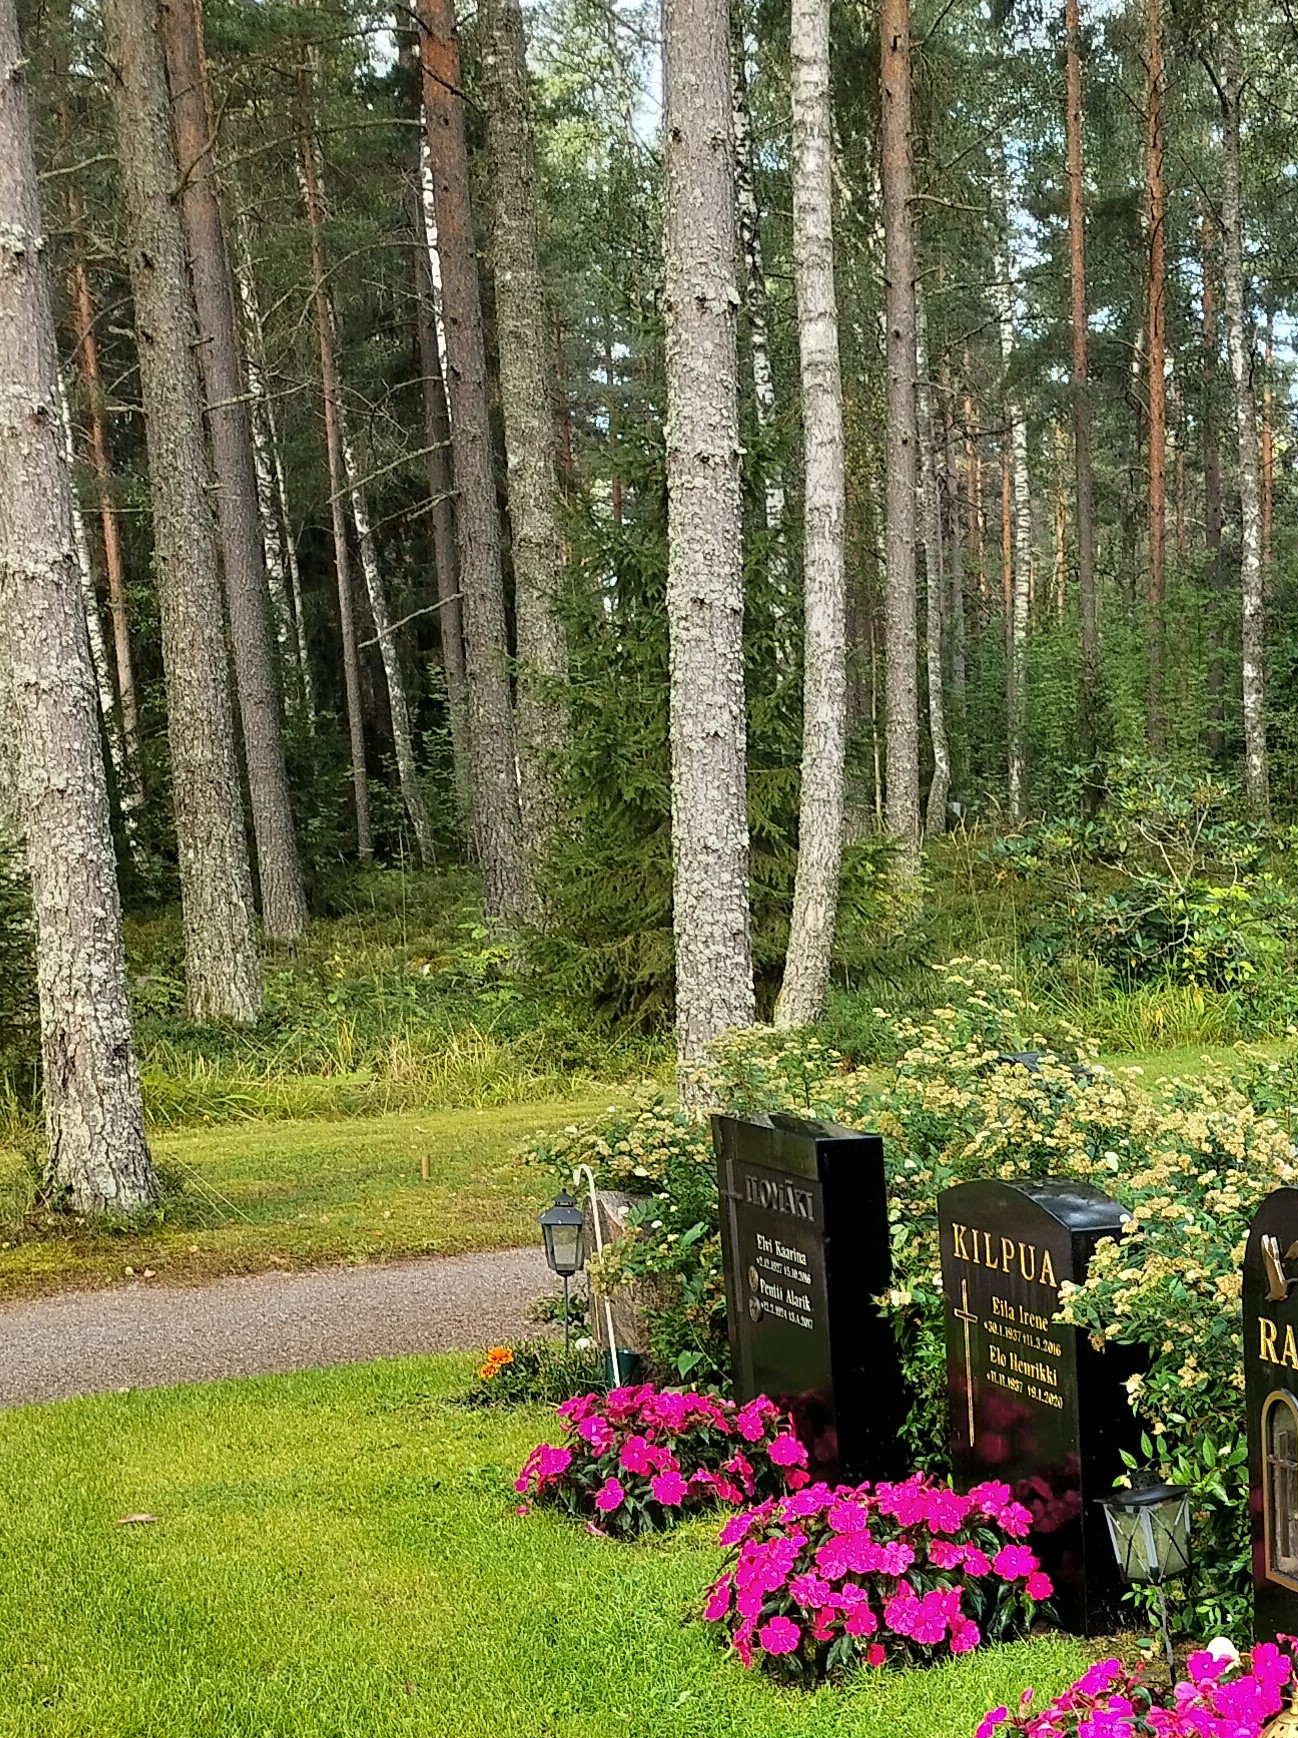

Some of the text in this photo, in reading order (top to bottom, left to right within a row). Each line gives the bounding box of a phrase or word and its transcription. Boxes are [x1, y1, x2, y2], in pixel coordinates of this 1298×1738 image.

[756, 1233, 807, 1265] Elvi Kaarina
[952, 1222, 1058, 1288] KILPUA
[760, 1277, 783, 1301] Pentti
[991, 1295, 1049, 1332] Eila Irene
[989, 1344, 1058, 1386] Elo Henrikki
